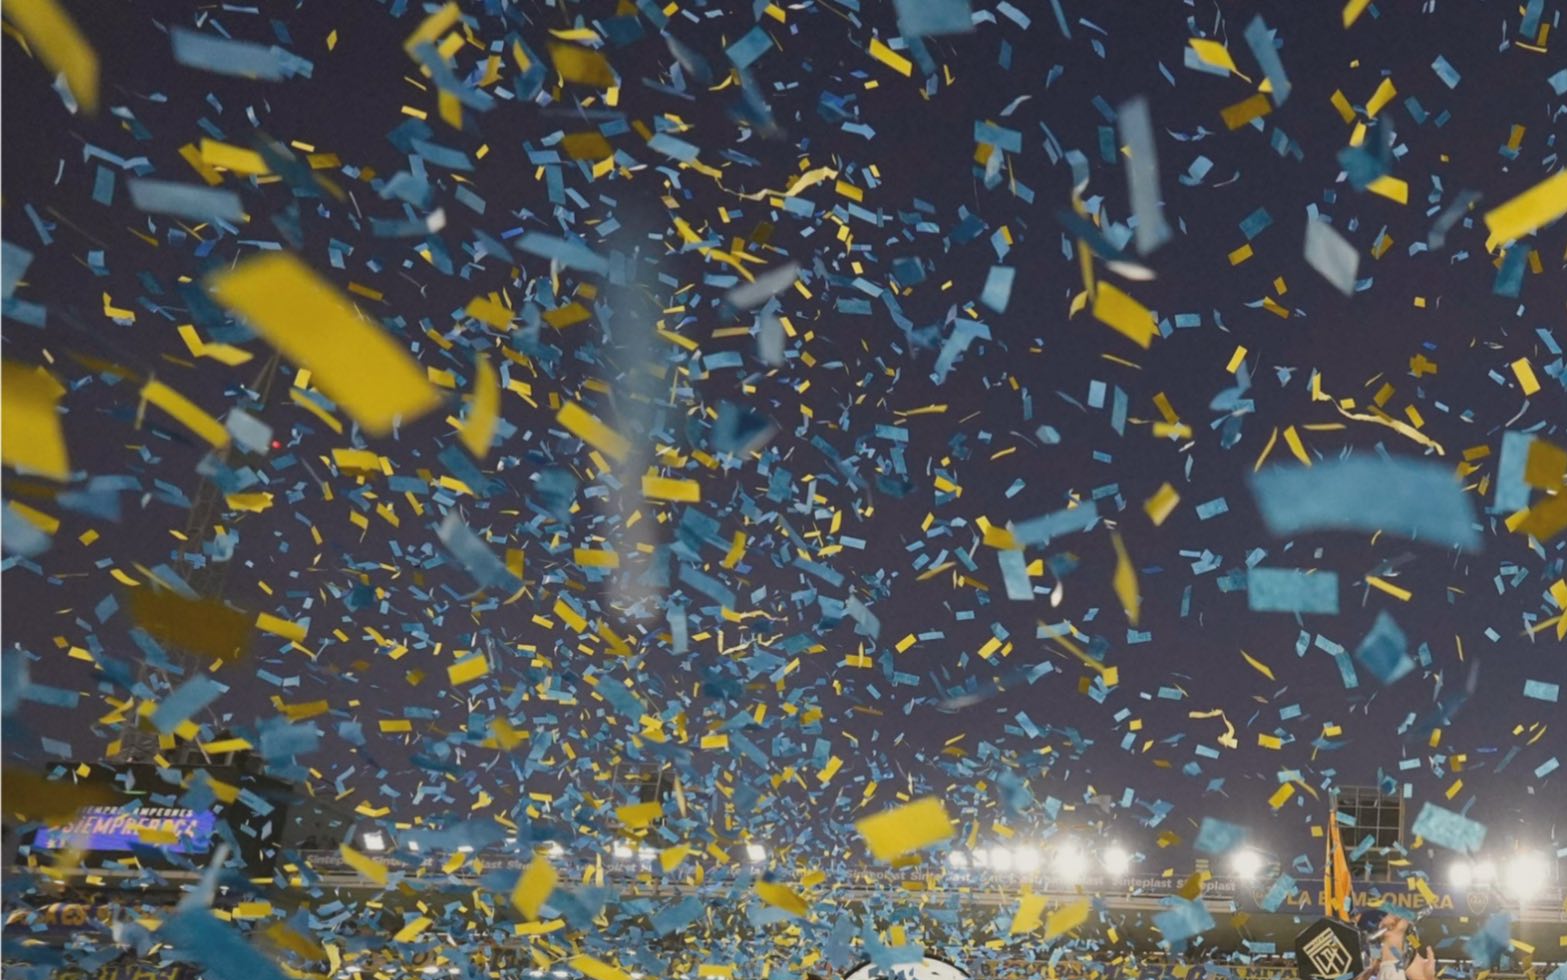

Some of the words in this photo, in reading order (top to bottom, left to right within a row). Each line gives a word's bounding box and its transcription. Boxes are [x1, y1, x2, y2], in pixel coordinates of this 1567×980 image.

[1176, 879, 1236, 891] Seplast
[1287, 891, 1312, 905] LA
[1319, 892, 1454, 908] BMONERA
